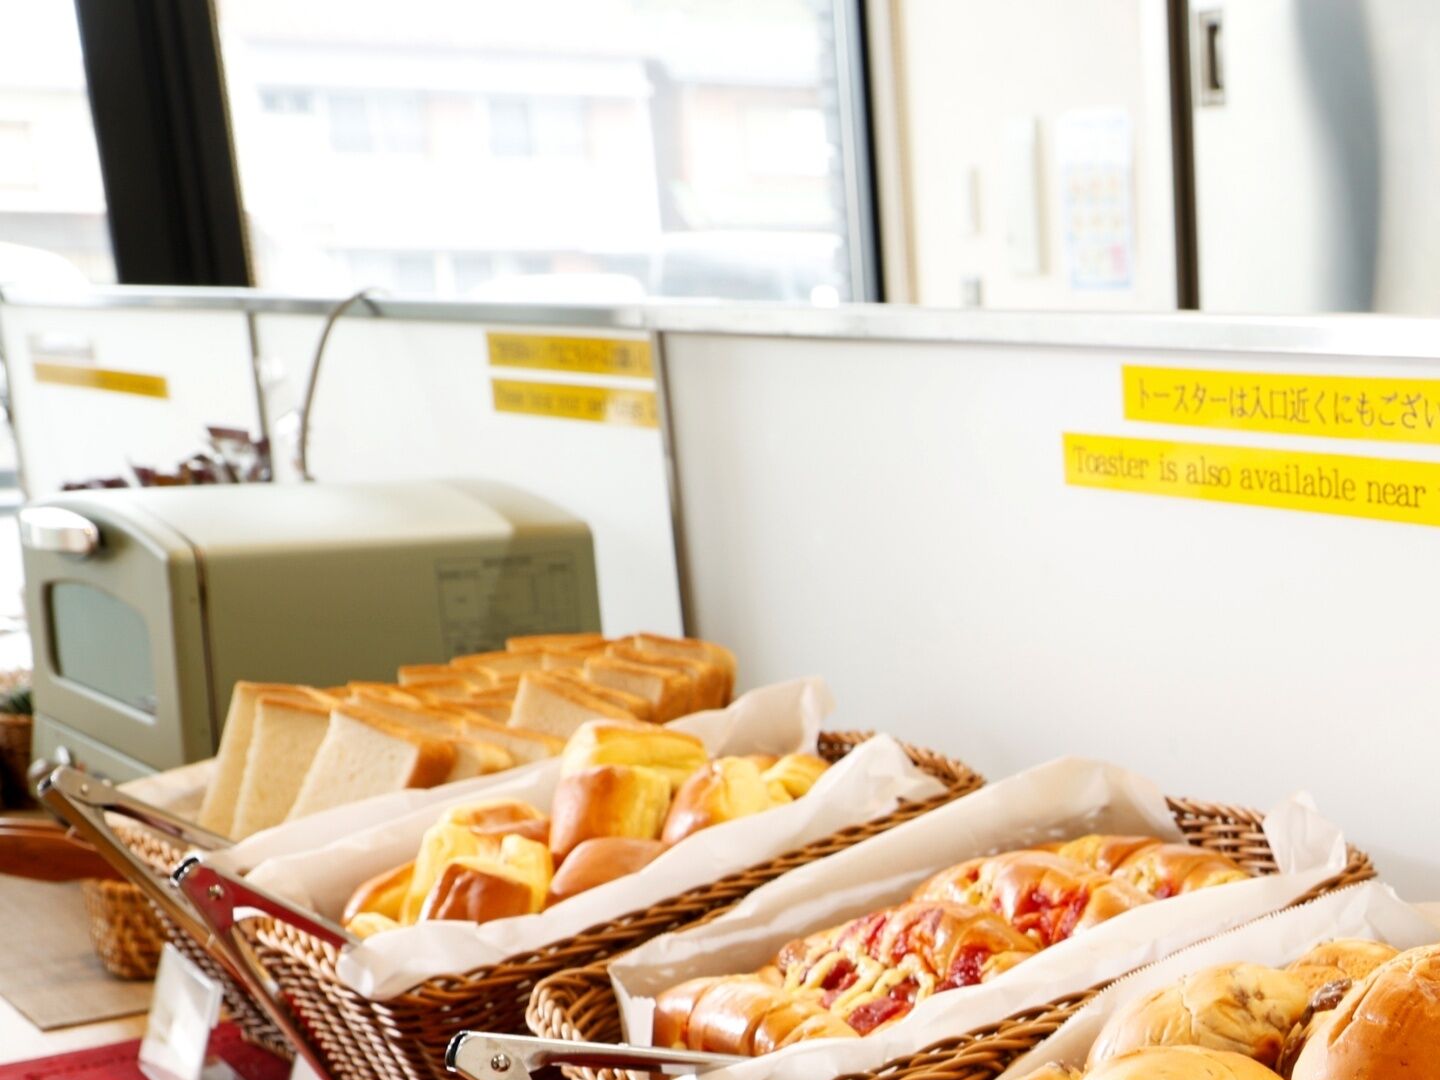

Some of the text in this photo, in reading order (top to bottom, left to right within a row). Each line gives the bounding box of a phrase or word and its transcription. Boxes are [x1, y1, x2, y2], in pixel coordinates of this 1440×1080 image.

[1072, 445, 1149, 480] Toaster
[1159, 453, 1178, 483] is
[1185, 455, 1232, 488] also
[1239, 464, 1356, 503] available
[1366, 479, 1426, 508] near
